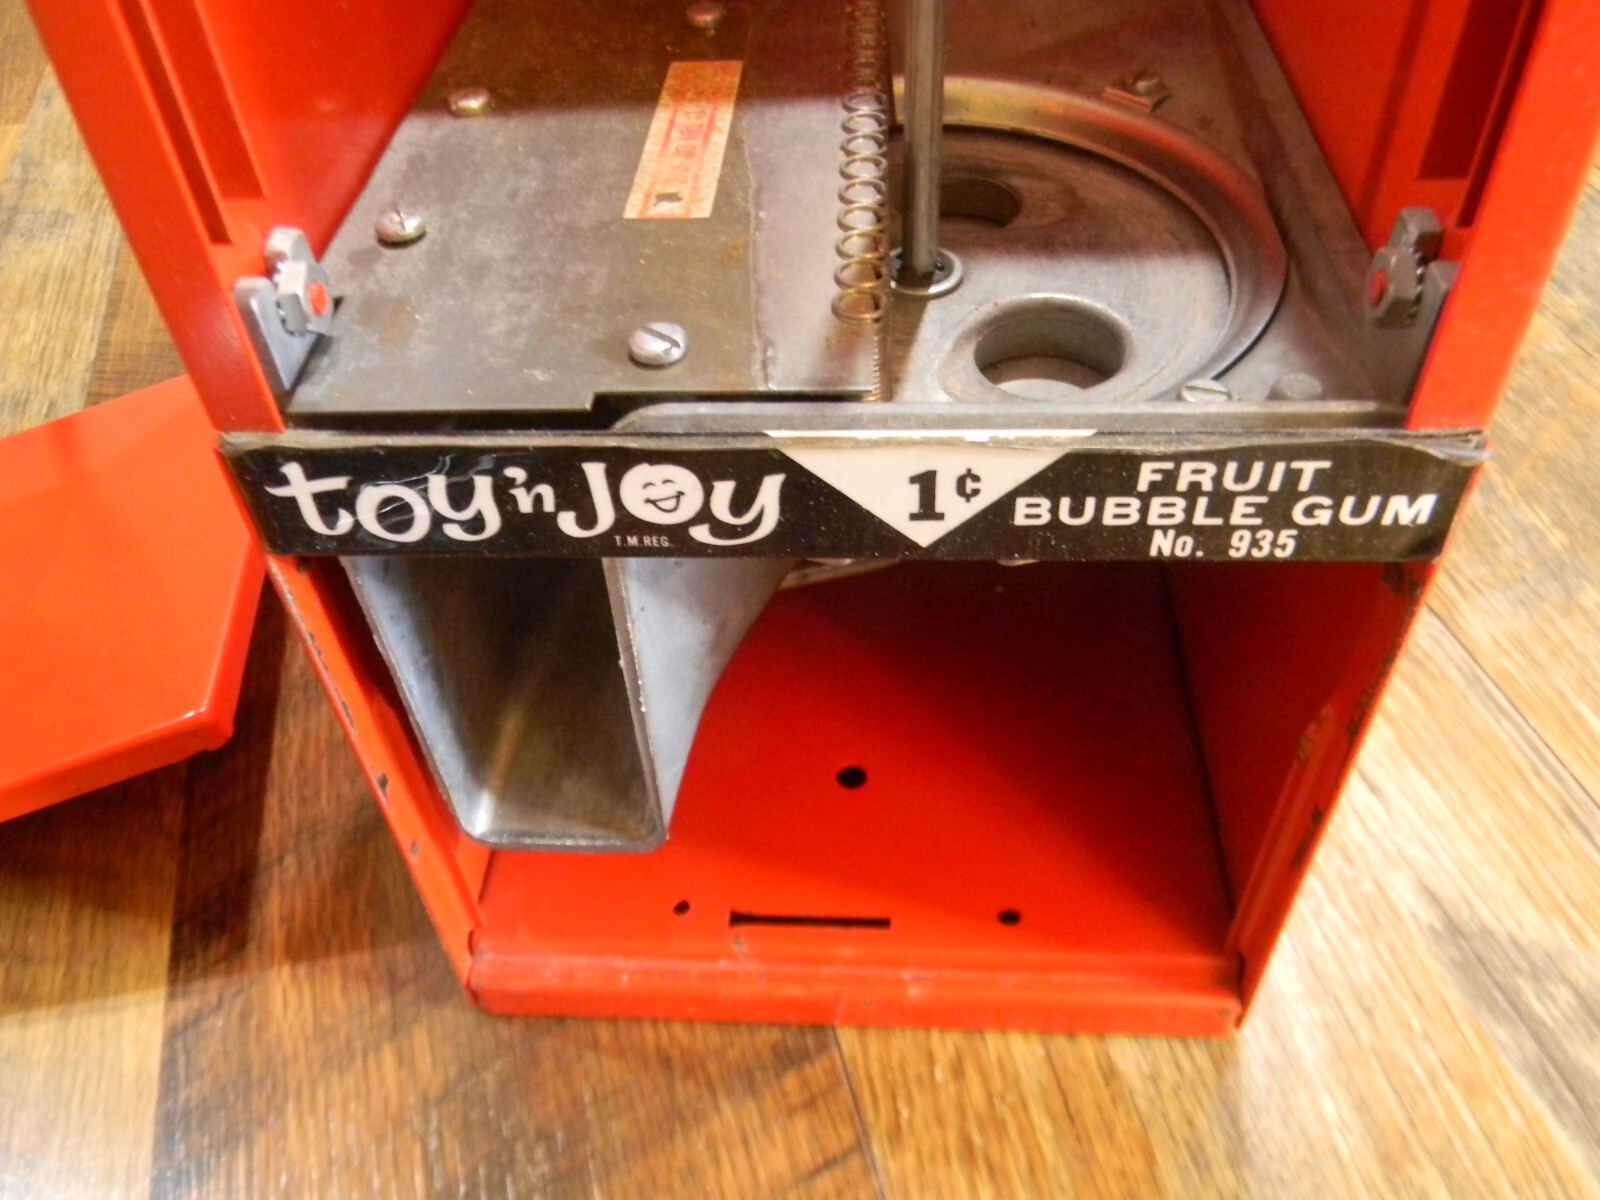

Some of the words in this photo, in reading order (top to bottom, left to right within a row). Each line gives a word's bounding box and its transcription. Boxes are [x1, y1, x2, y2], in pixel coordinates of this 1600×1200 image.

[1136, 460, 1333, 493] FRUIT
[264, 461, 502, 543] toy
[1012, 495, 1267, 528] BUBBLE
[1291, 493, 1439, 528] GUM
[1149, 529, 1206, 558] No.
[1228, 529, 1299, 560] 935
